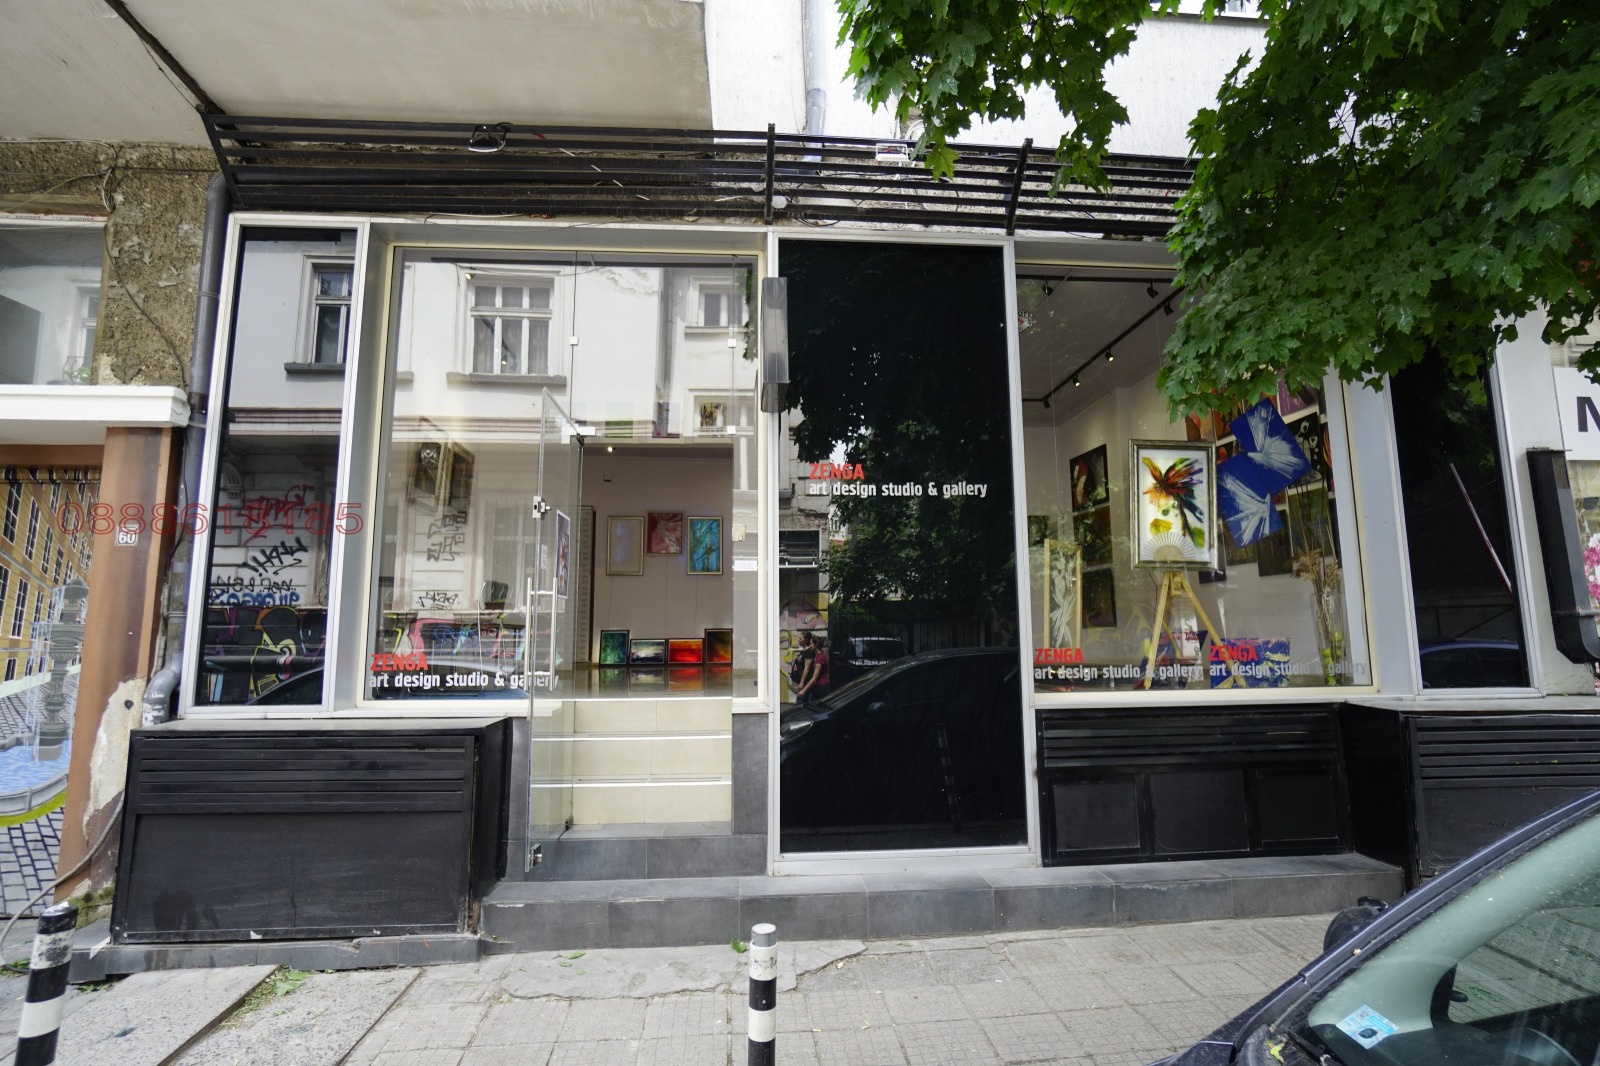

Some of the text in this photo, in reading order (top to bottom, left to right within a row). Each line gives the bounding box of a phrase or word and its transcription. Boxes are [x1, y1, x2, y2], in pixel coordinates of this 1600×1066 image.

[809, 463, 865, 480] ZENGA
[809, 481, 988, 498] art design studio & gallery
[119, 531, 135, 543] 60
[1034, 648, 1085, 664] ZENGA
[1209, 645, 1259, 661] ZENGA
[370, 653, 428, 671] ZENGA
[1209, 663, 1227, 676] art
[1232, 662, 1270, 678] design
[1274, 662, 1311, 676] studio
[1328, 661, 1366, 677] gallery
[369, 673, 389, 688] art
[395, 672, 440, 689] design
[446, 672, 488, 687] studio
[494, 673, 505, 687] &
[1034, 666, 1053, 679] art
[1058, 665, 1098, 681] design
[1102, 665, 1141, 678] studio
[1159, 664, 1203, 679] gallery
